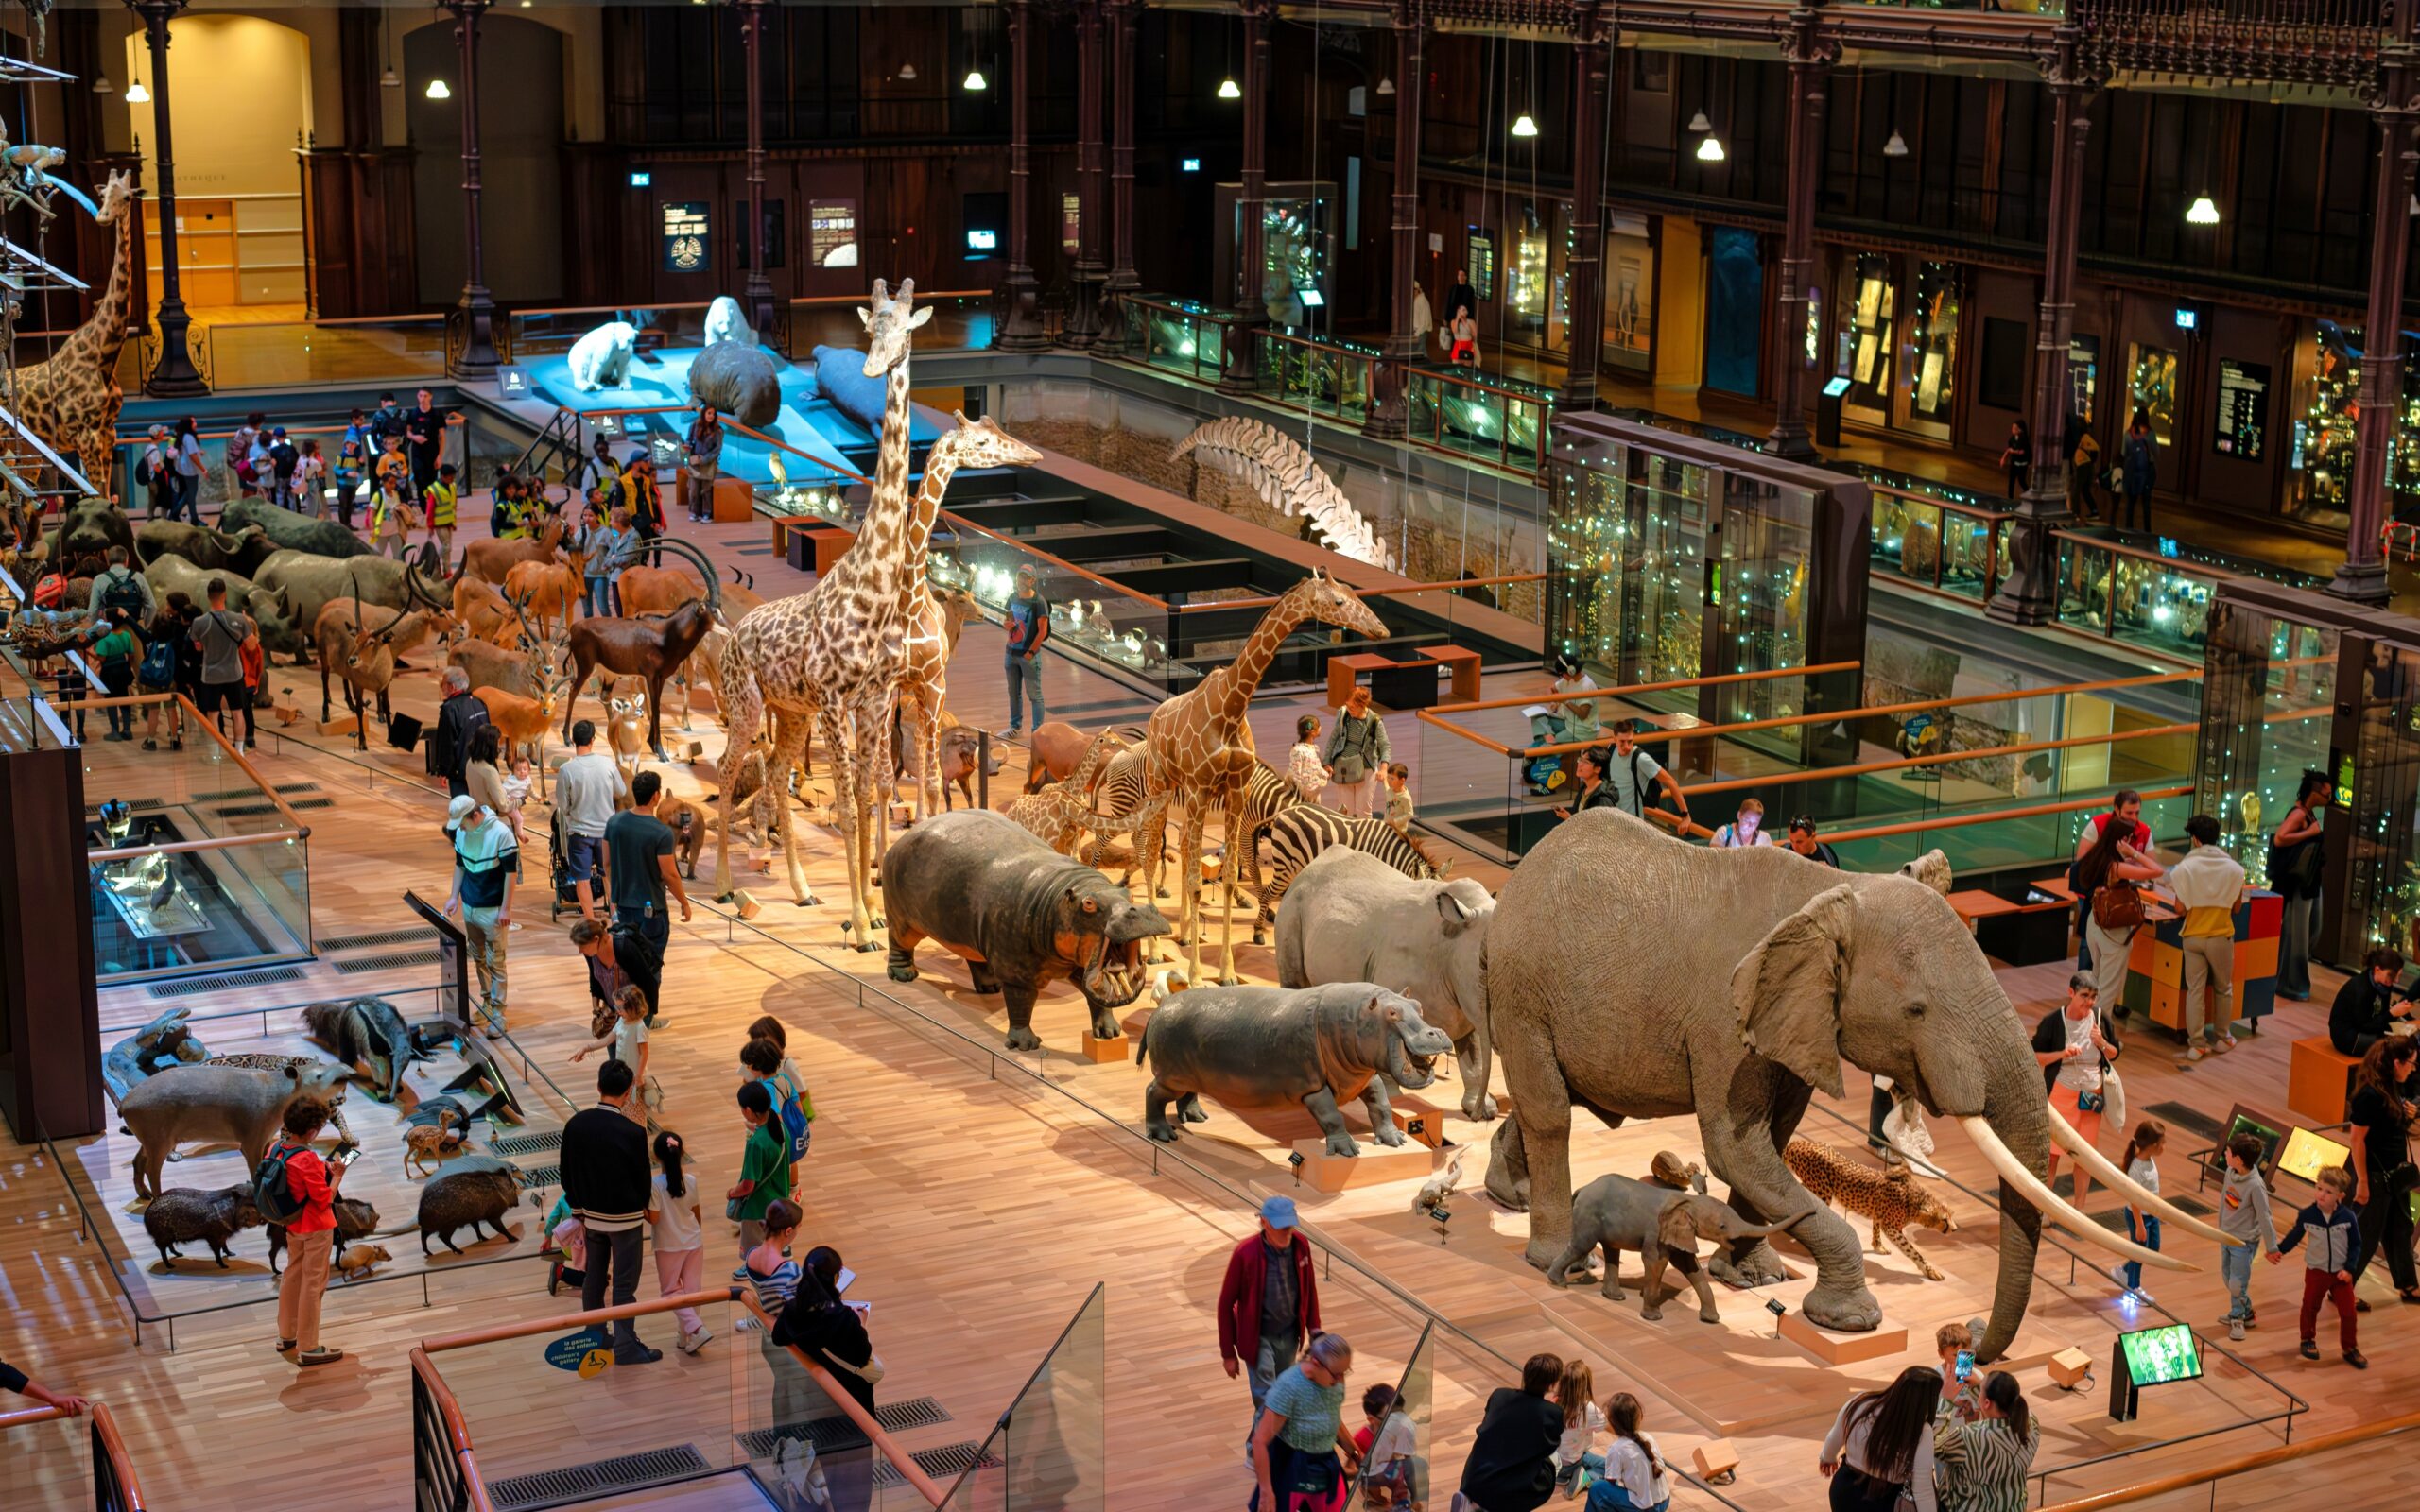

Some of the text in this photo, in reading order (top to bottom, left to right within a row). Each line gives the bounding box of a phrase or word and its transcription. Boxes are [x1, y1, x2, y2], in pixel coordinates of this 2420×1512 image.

[571, 1337, 592, 1346] galerie
[577, 1341, 598, 1349] enfants
[560, 1358, 579, 1366] gallery
